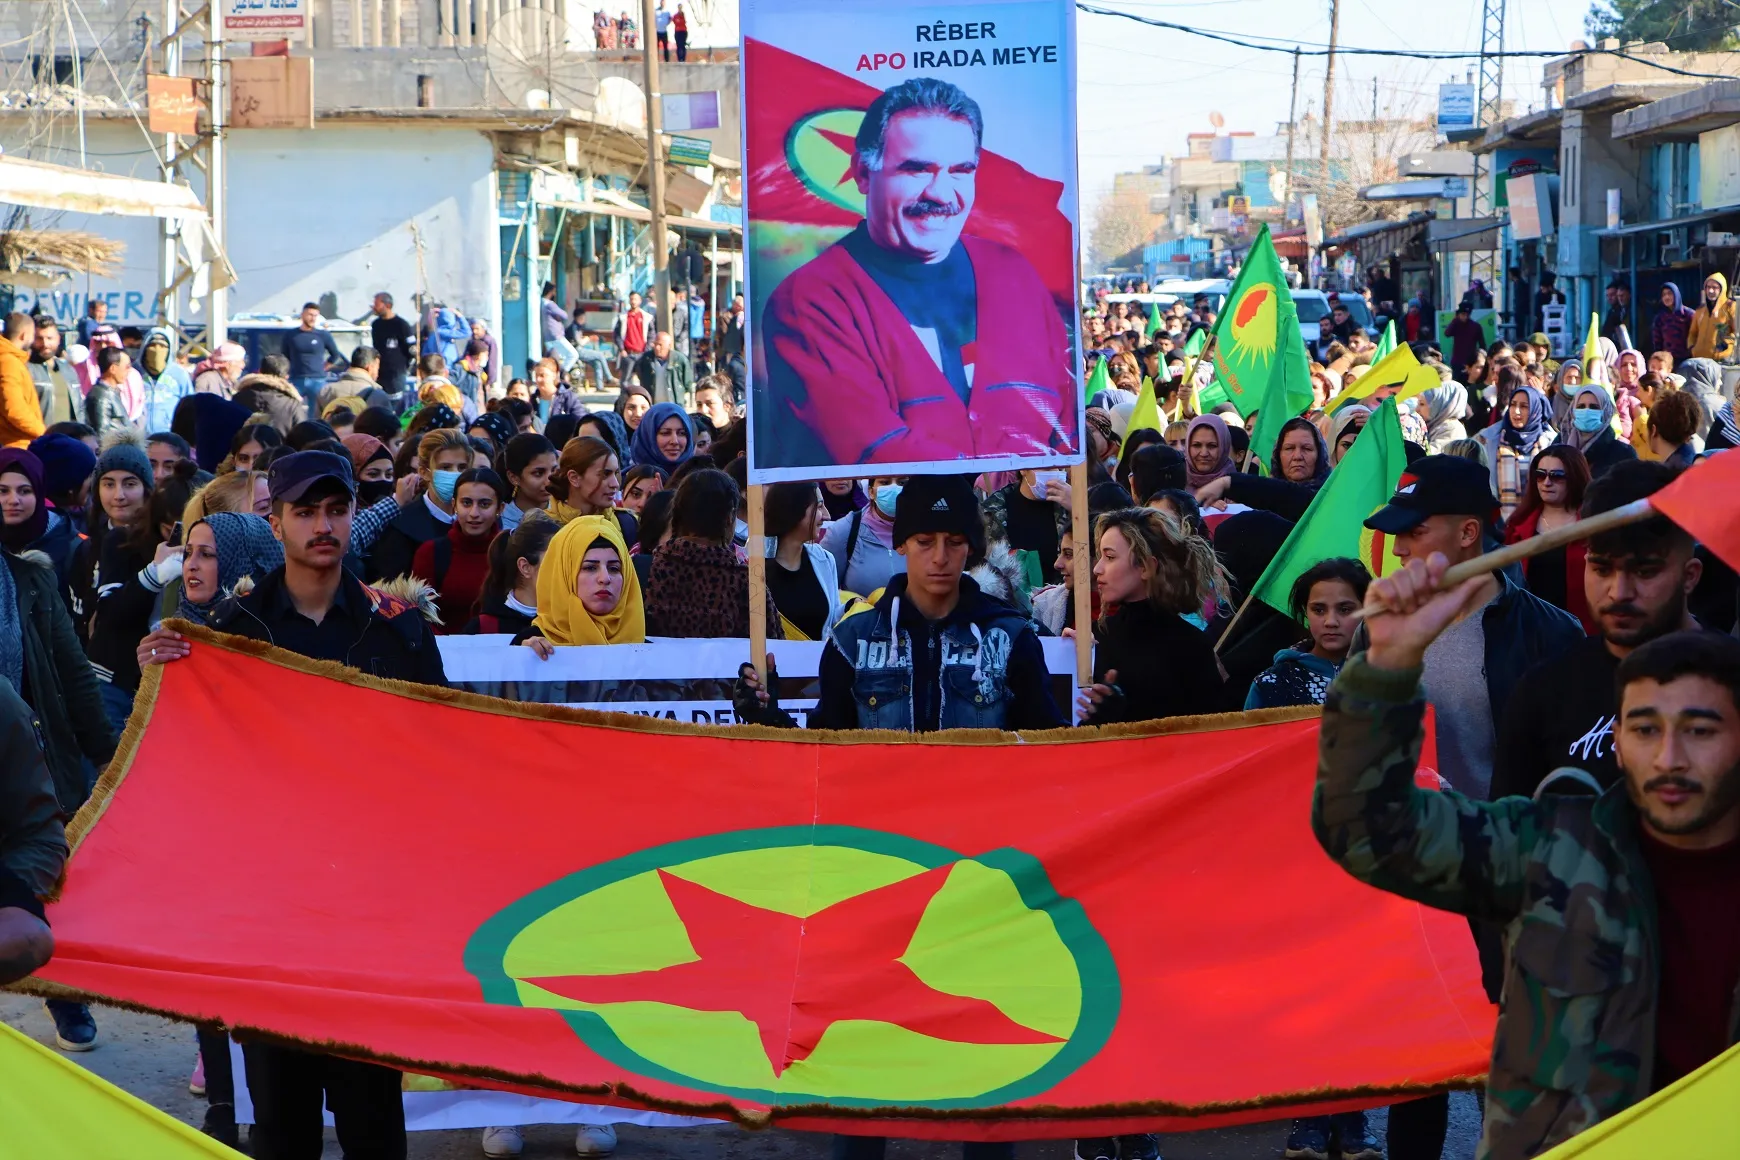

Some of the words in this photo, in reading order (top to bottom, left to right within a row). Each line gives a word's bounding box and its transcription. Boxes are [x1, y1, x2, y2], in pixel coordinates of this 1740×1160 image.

[916, 20, 996, 42] RÊBER
[856, 52, 906, 71] APO
[913, 48, 986, 68] IRADA
[993, 45, 1058, 65] MEYE
